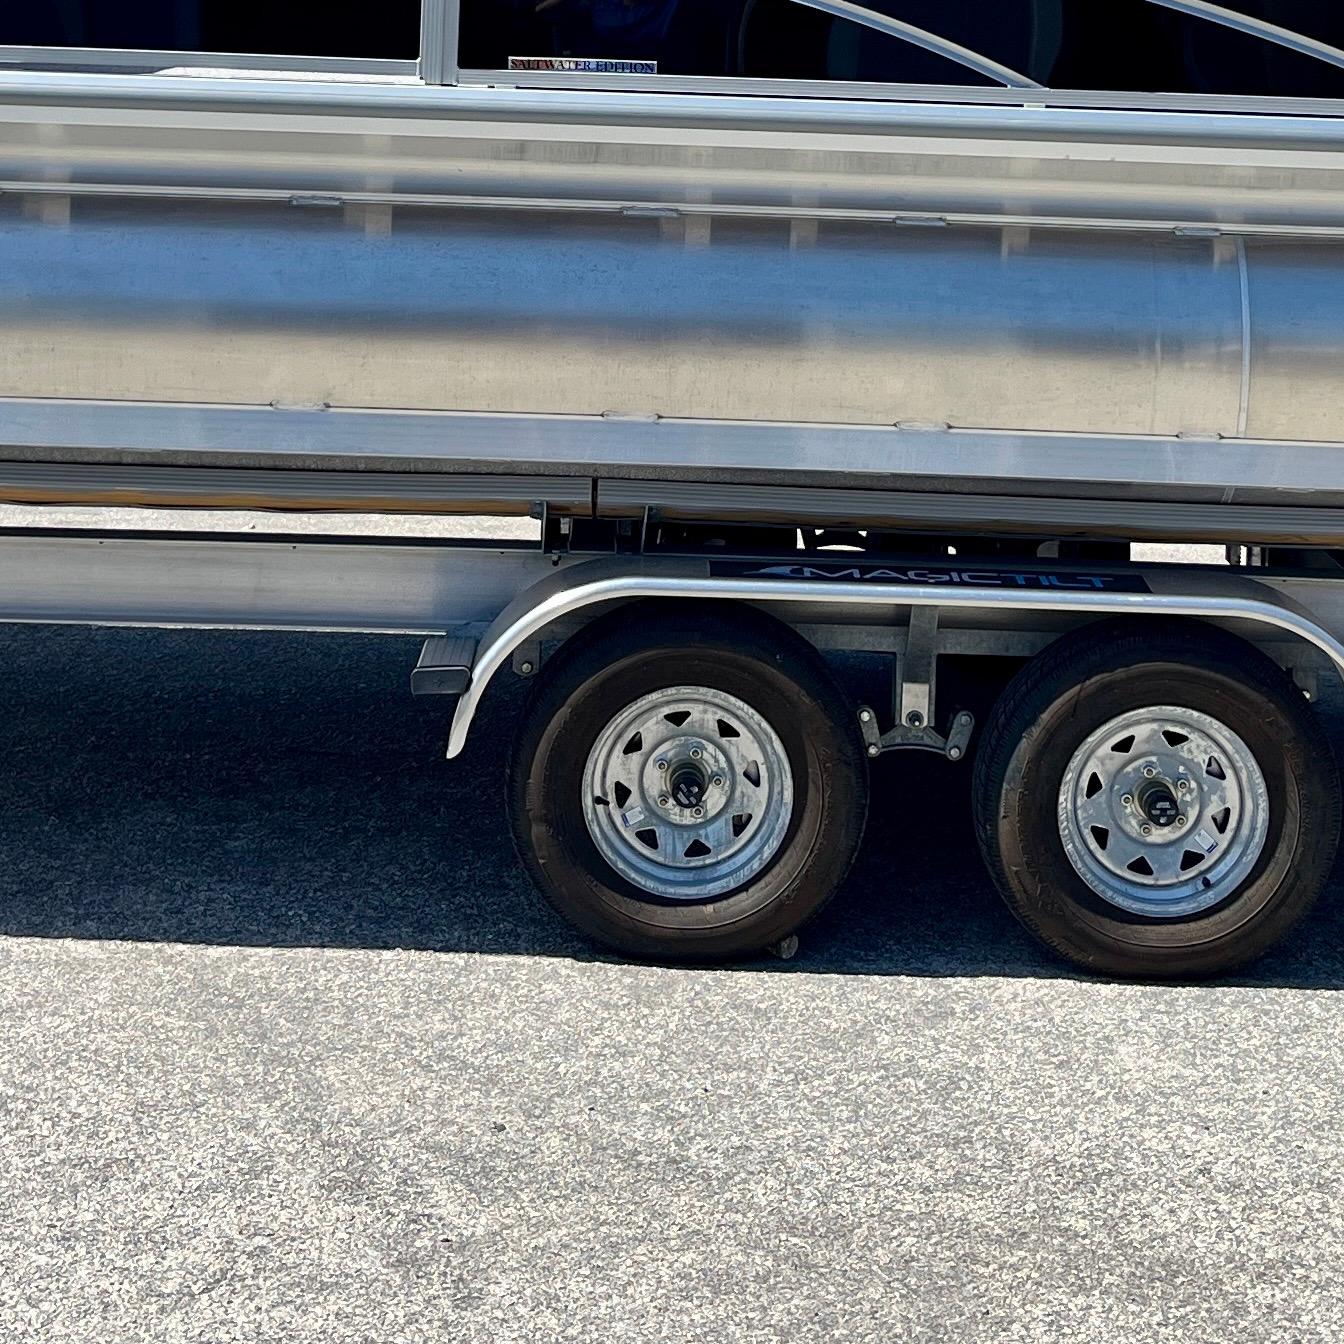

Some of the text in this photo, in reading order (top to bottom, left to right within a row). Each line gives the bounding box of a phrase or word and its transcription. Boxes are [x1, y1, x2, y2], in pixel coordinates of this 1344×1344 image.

[510, 58, 655, 73] SALTWATER EDITION
[803, 566, 1114, 588] MAGICTILT
